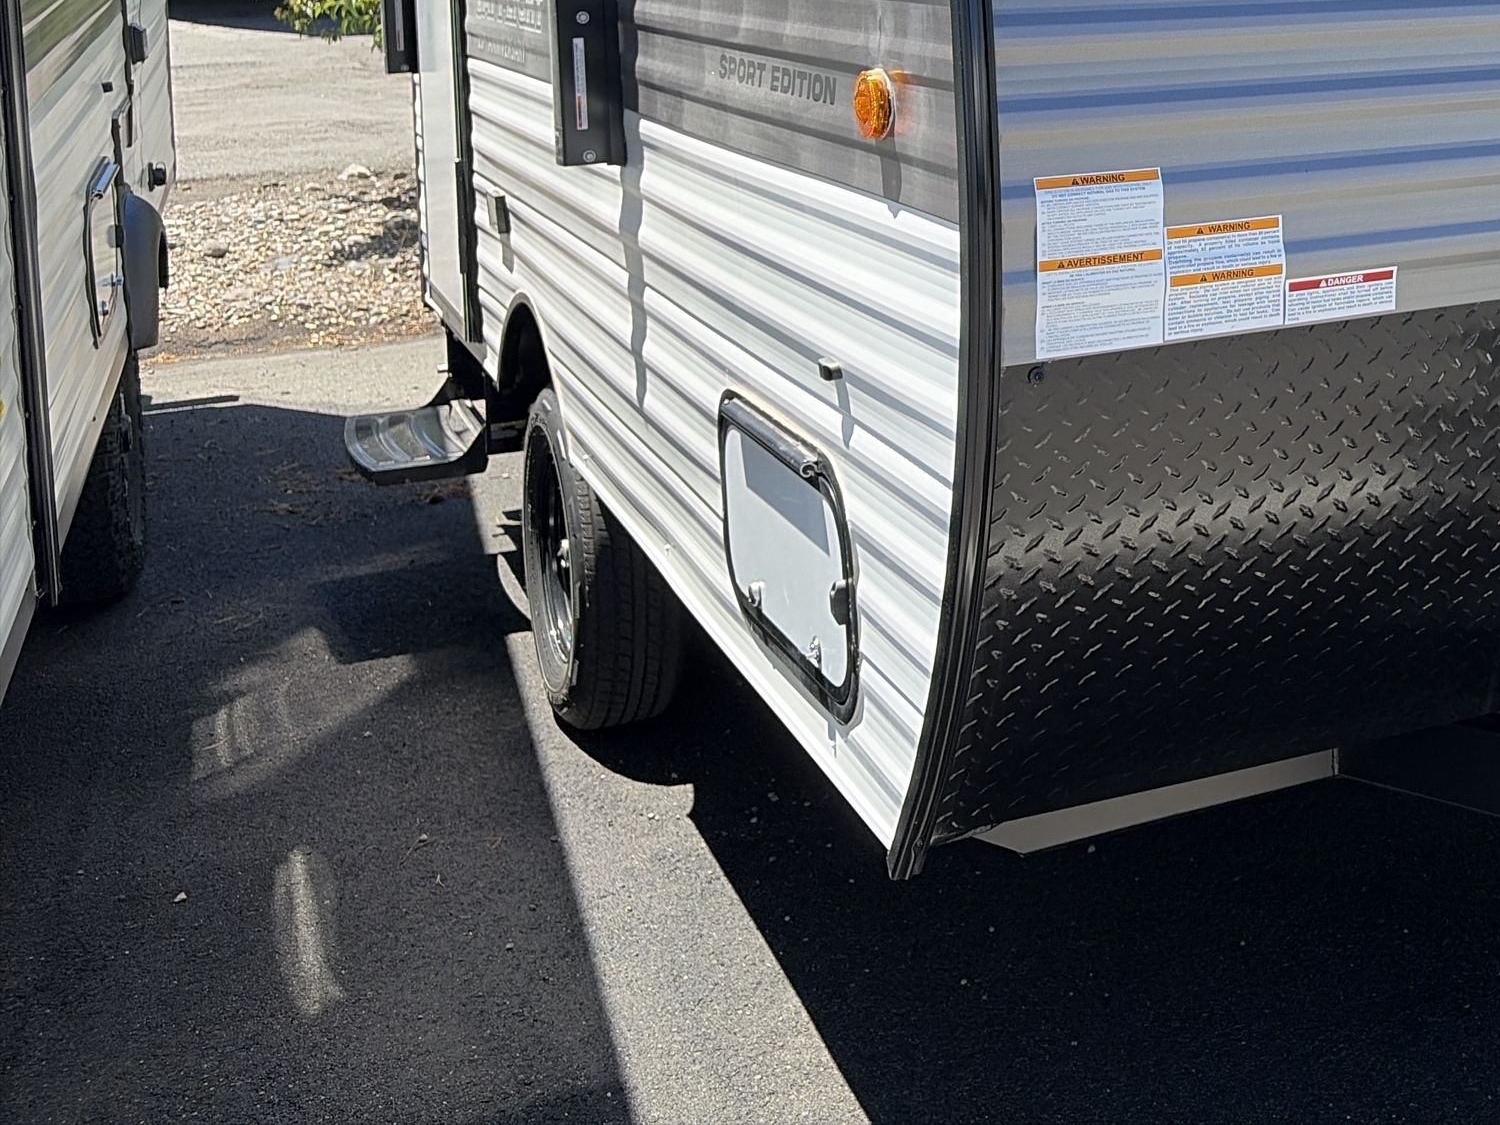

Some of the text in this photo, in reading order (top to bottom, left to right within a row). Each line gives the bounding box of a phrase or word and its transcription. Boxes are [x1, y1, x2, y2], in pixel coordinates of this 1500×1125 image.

[719, 54, 837, 105] SPORT EDITION
[1080, 174, 1125, 184] WARNING
[1208, 222, 1250, 233] WARNING
[1066, 253, 1144, 268] AVERTISSEMENT
[1212, 269, 1254, 280] WARNING
[1327, 275, 1363, 286] DANGER
